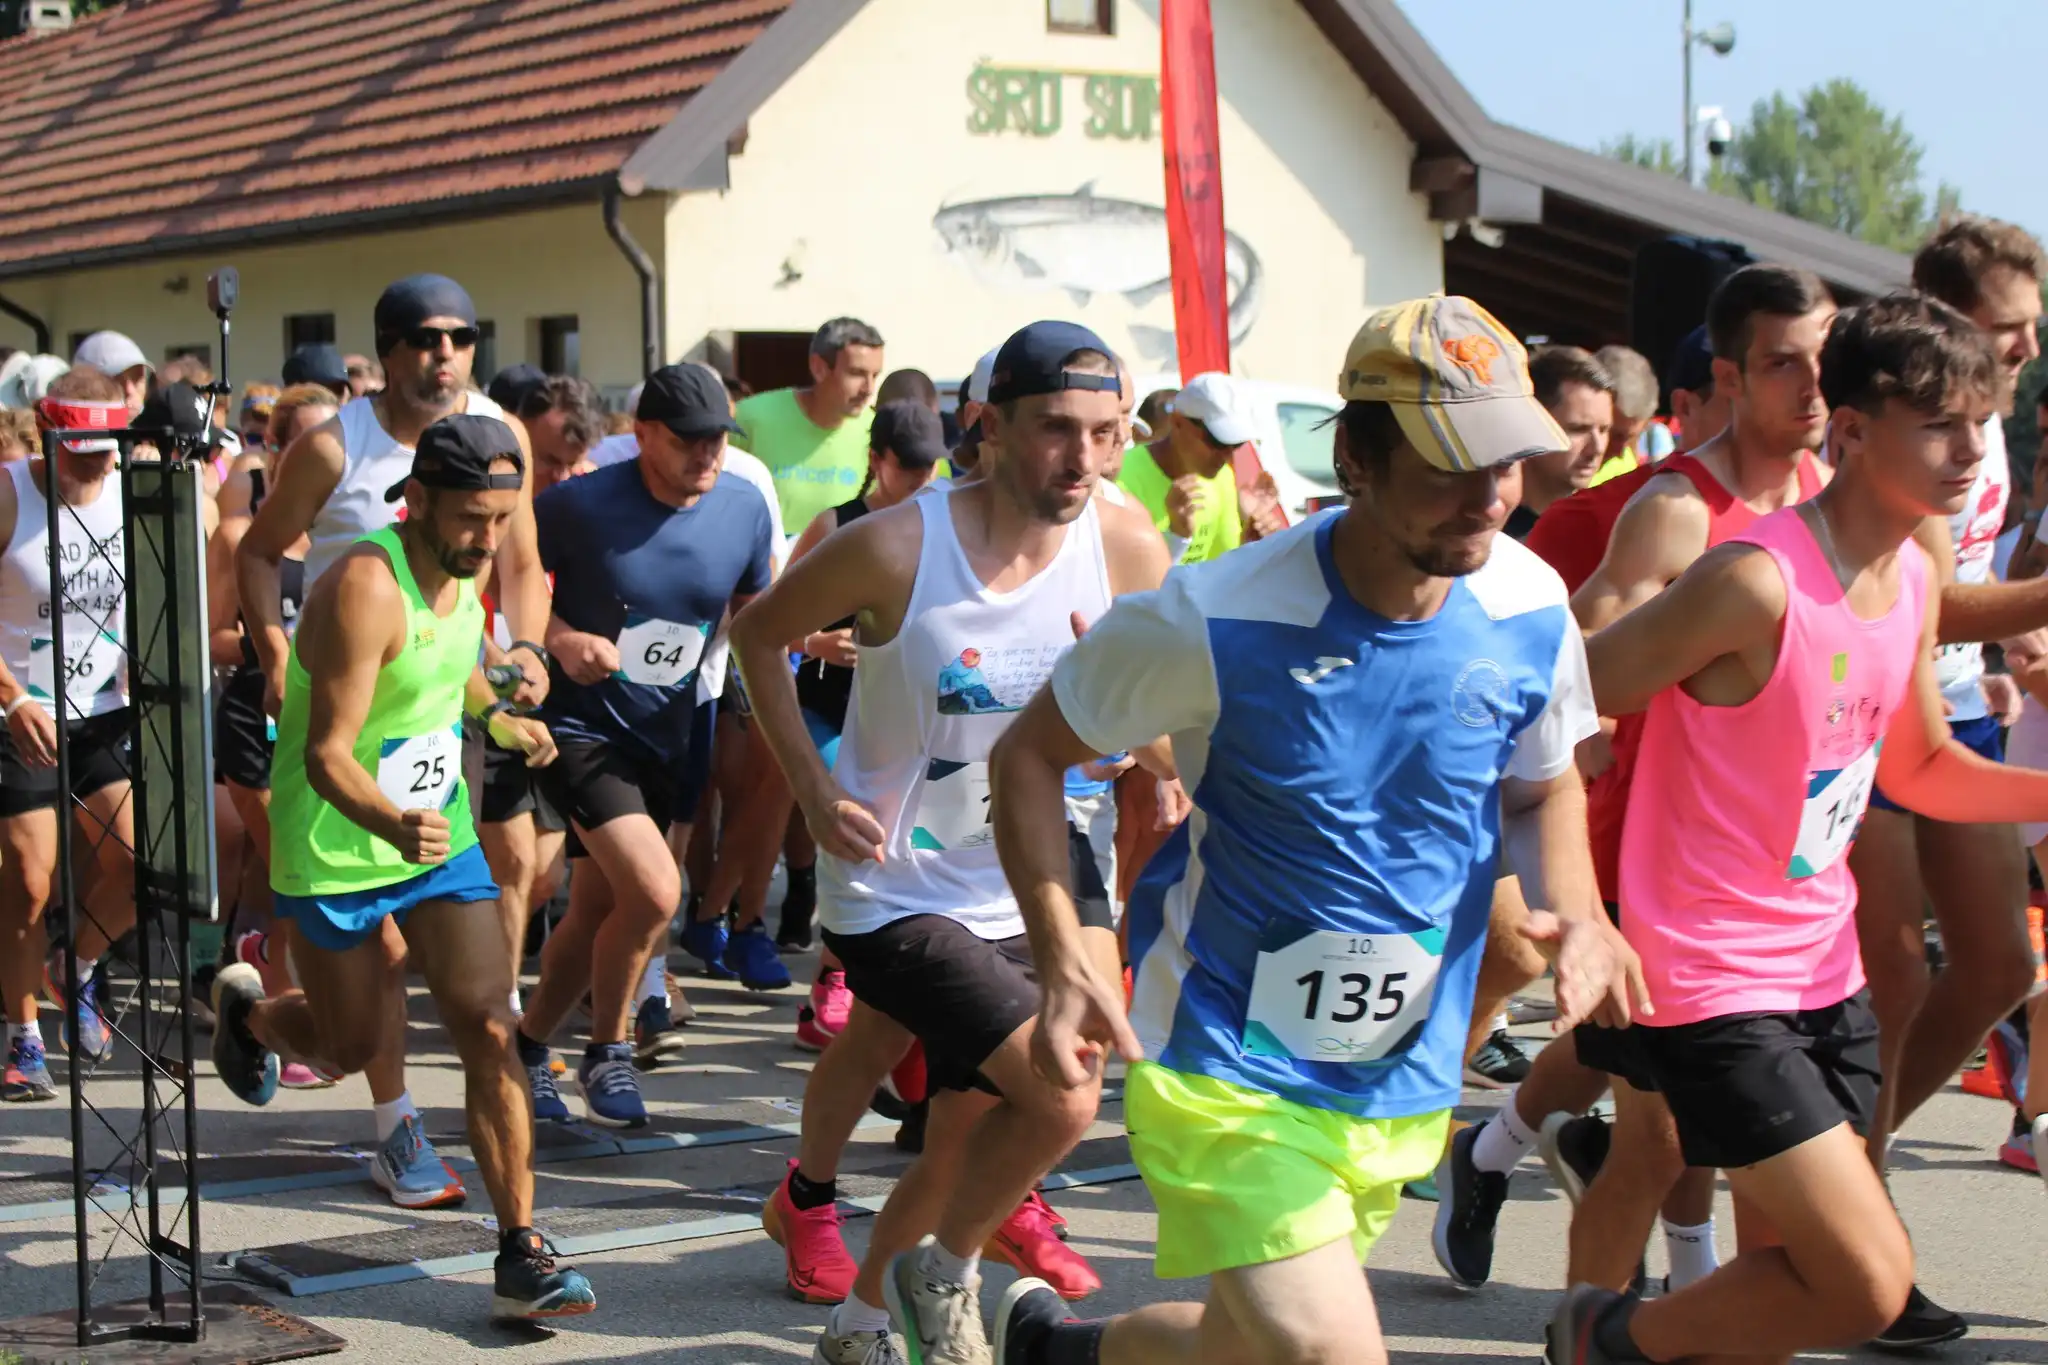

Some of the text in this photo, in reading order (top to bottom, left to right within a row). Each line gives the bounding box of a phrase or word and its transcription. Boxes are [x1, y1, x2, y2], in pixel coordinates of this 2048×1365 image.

[104, 567, 116, 588] A
[643, 641, 684, 668] 64
[409, 755, 446, 793] 25
[1347, 938, 1378, 955] 10.
[1296, 970, 1408, 1023] 135
